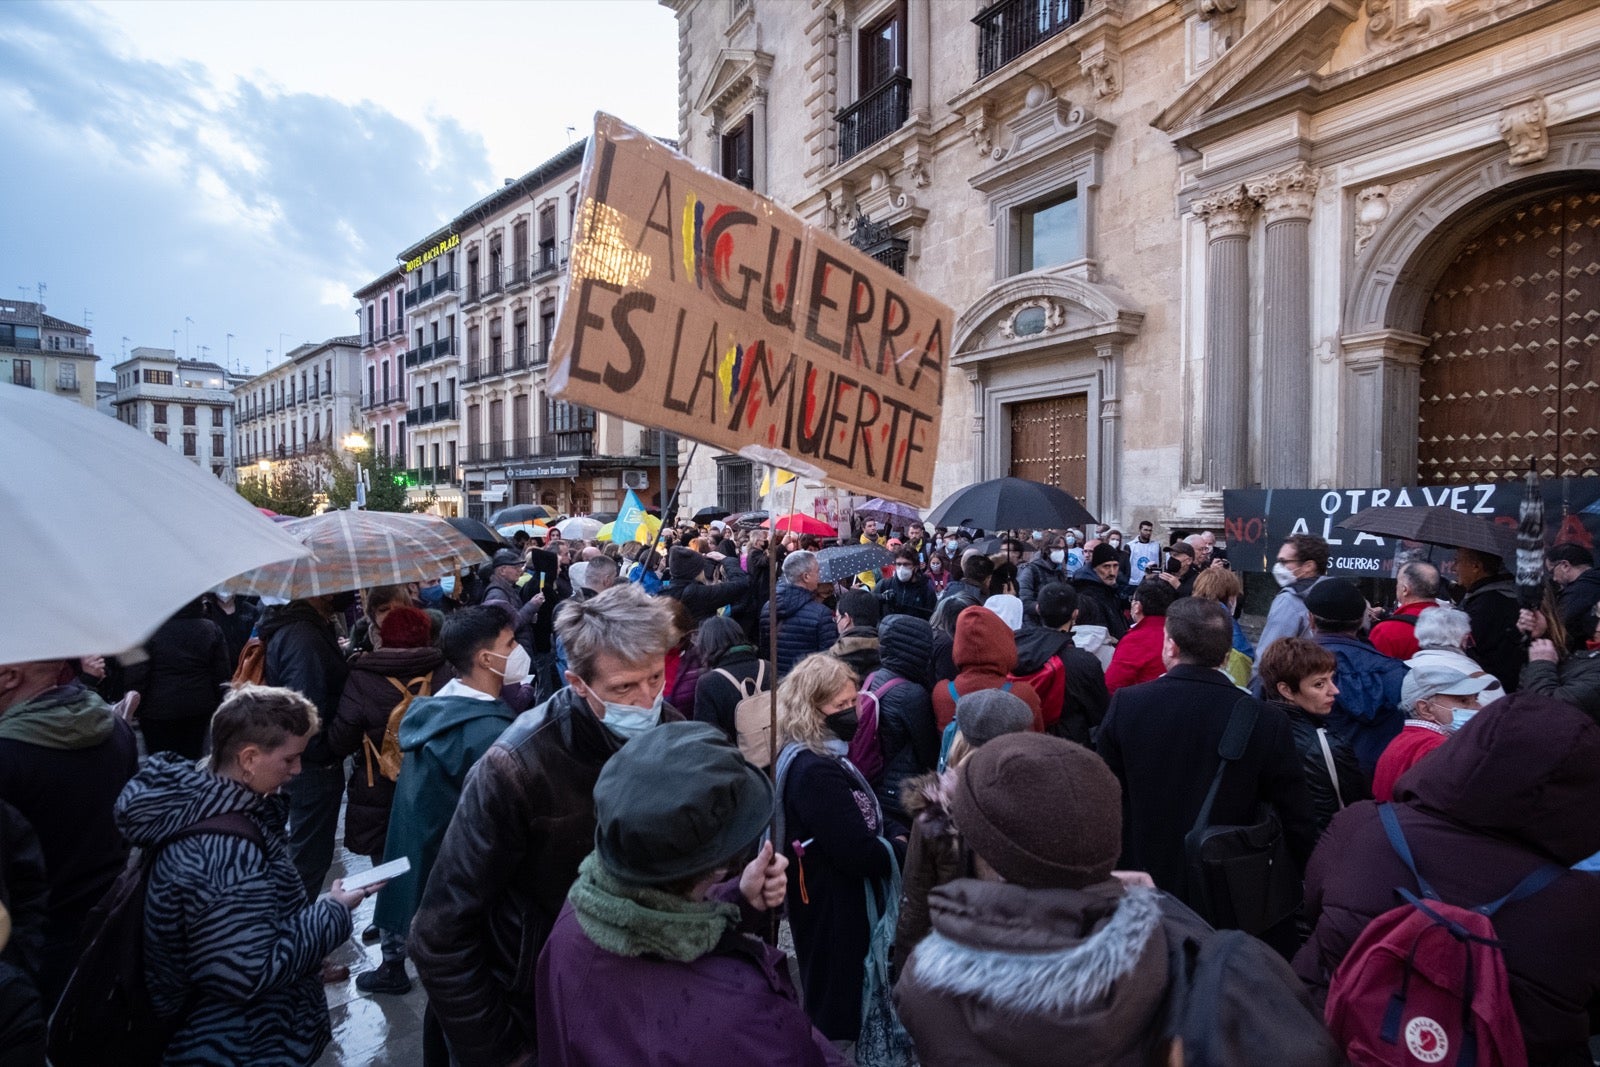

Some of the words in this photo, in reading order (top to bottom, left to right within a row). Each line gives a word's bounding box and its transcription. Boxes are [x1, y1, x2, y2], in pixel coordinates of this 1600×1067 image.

[406, 256, 422, 272] HOTEL
[440, 234, 459, 254] PLAZA
[588, 138, 675, 282] LA
[705, 210, 944, 407] GUERRA
[569, 278, 656, 393] ES
[662, 307, 717, 425] LA
[727, 339, 933, 493] MUERTE
[1320, 489, 1414, 515] OTRA
[1422, 484, 1496, 514] VEZ
[1224, 516, 1263, 544] NO
[1335, 556, 1381, 571] GUERRAS
